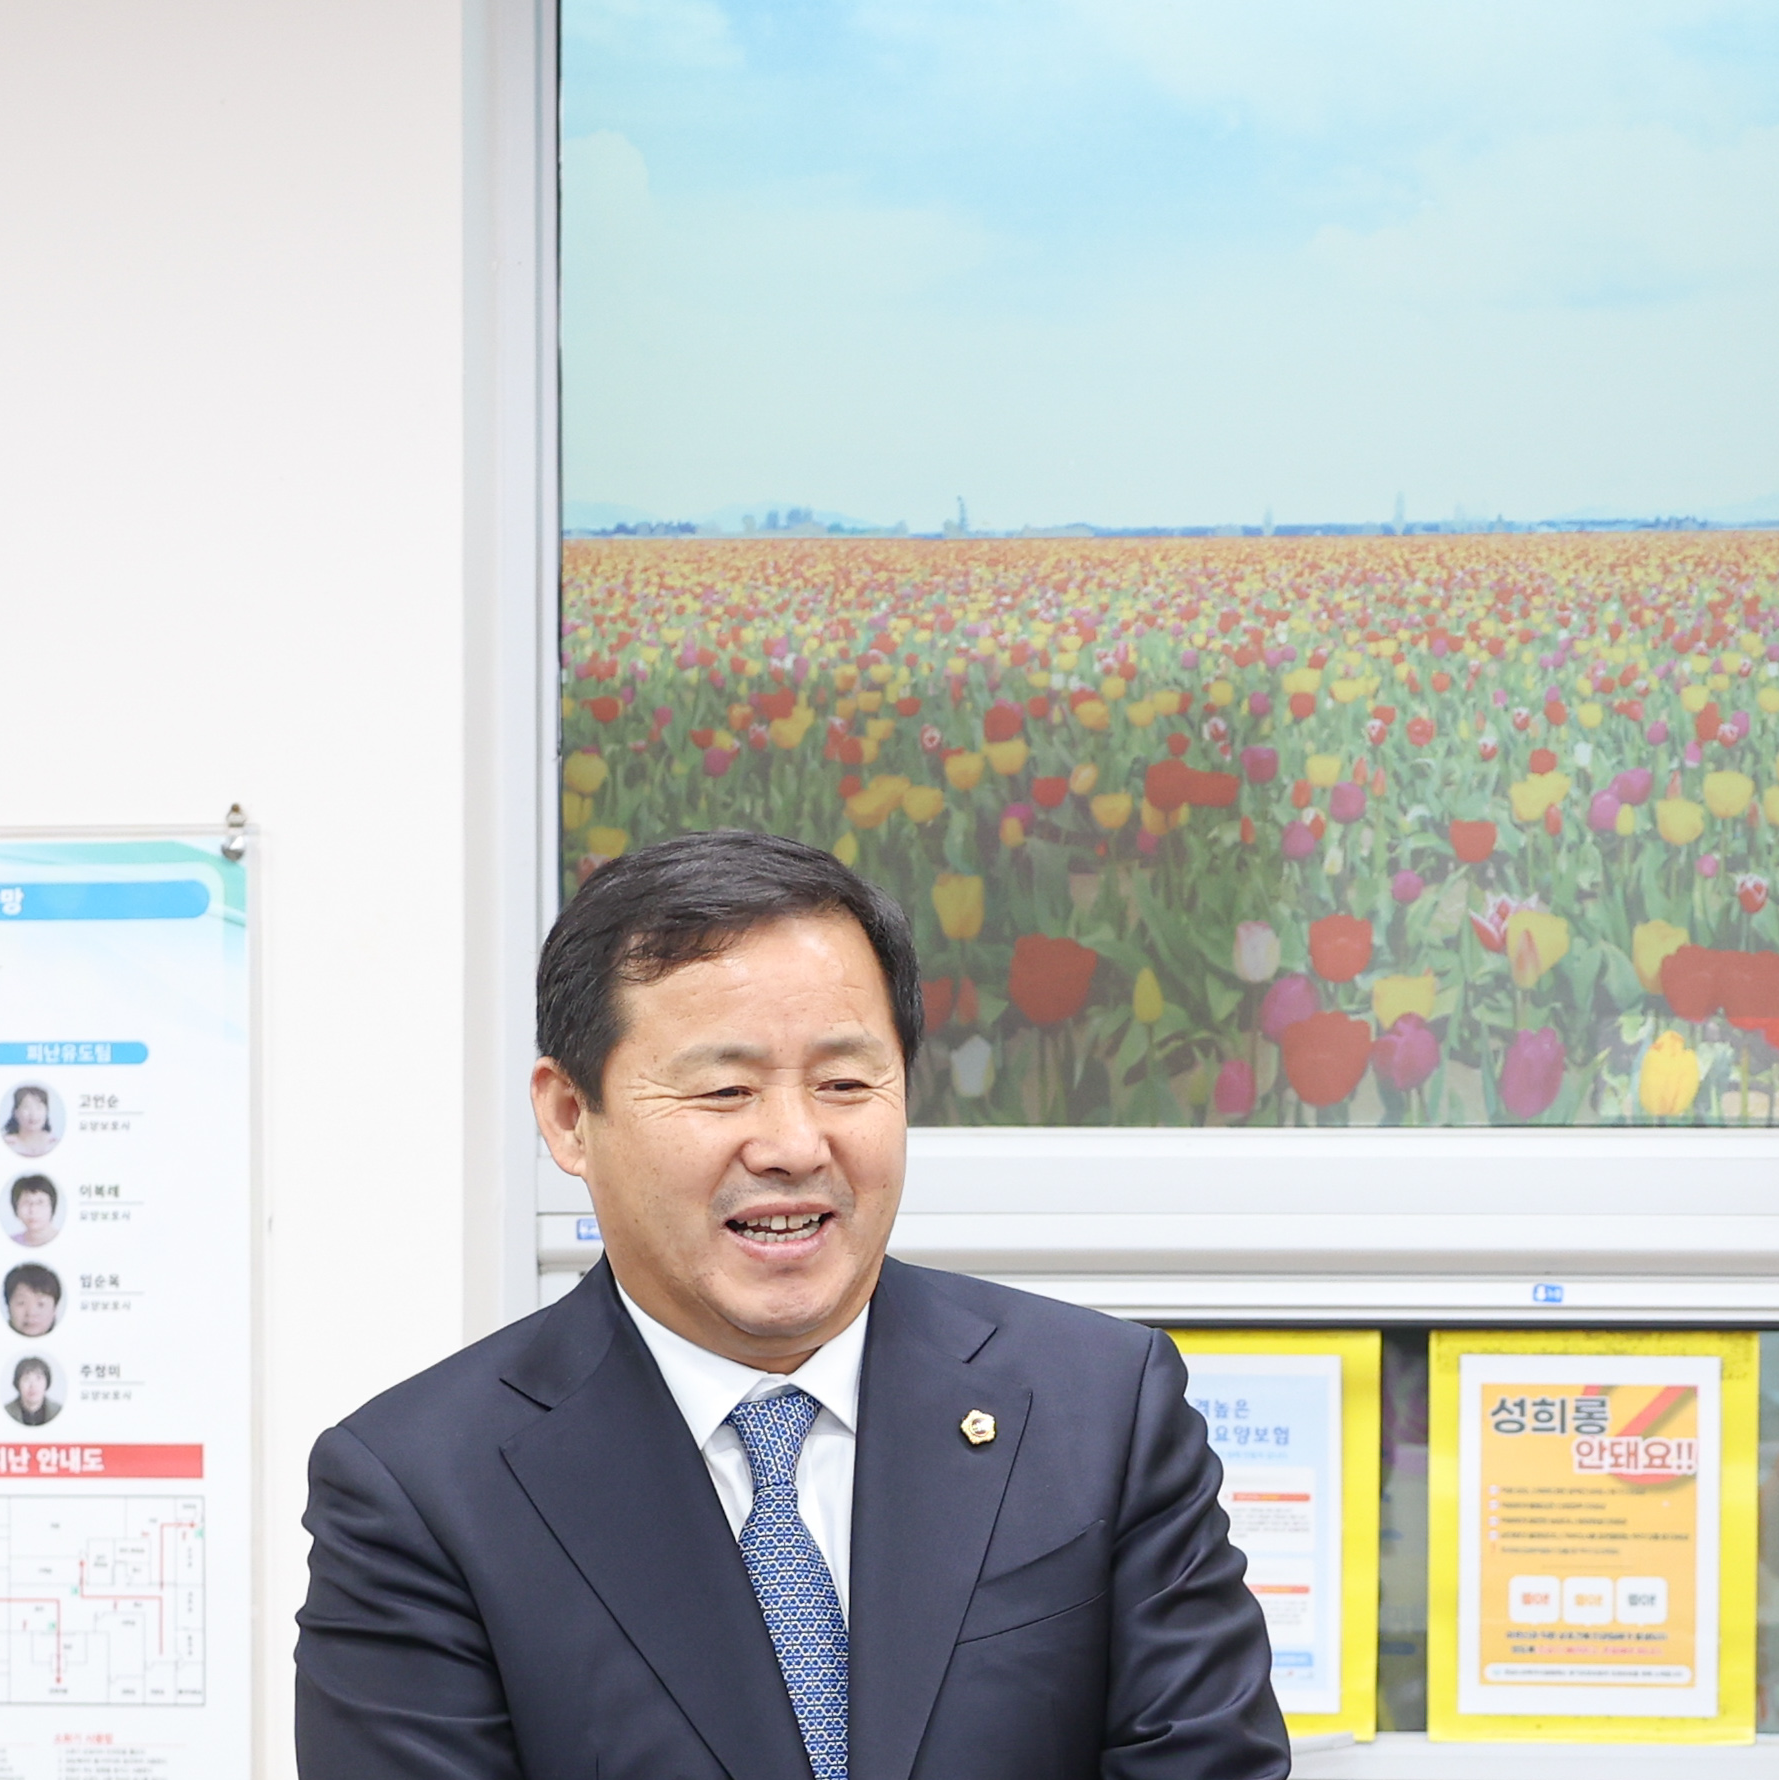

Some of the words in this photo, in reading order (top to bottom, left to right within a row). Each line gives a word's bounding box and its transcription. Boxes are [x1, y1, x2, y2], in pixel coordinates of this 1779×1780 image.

[25, 1042, 113, 1065] 피난유도팀
[1490, 1396, 1610, 1436] 성희롱
[1214, 1424, 1290, 1446] 요양보험
[36, 1446, 105, 1473] 안내도
[1575, 1439, 1694, 1471] 안돼요!!
